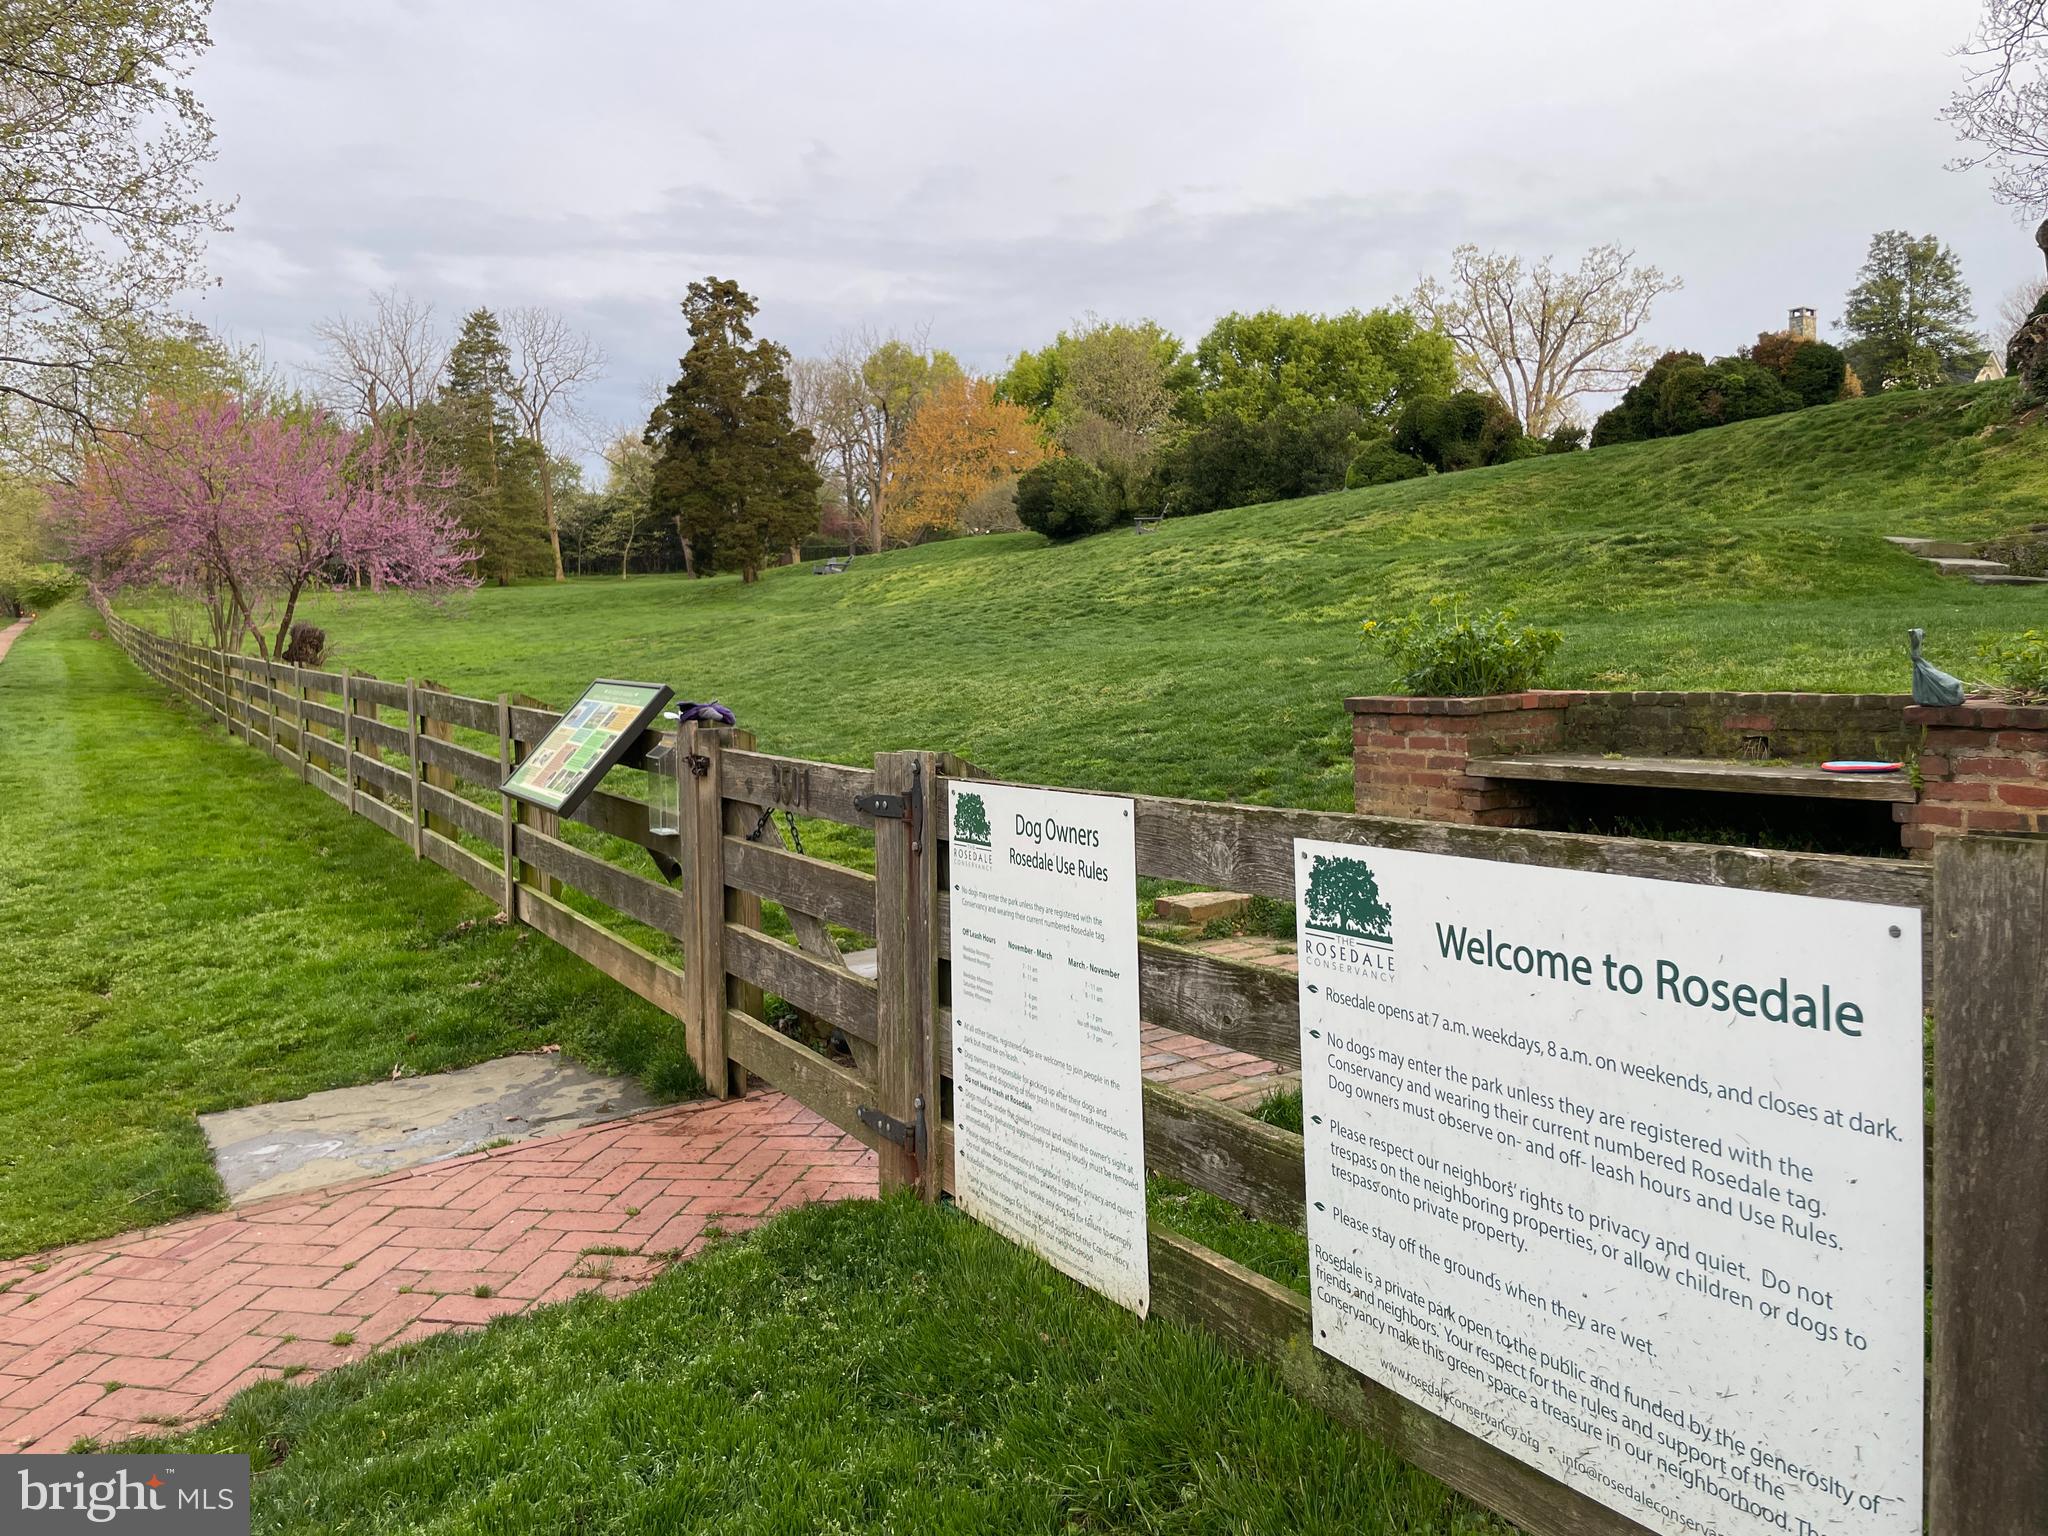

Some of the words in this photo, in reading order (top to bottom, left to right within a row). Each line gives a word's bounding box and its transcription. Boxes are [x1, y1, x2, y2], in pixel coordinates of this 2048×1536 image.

[953, 847, 993, 865] ROSEDALE
[1009, 847, 1054, 872] Rosedale
[1055, 855, 1076, 876] Use
[1078, 859, 1109, 882] Rules
[1015, 813, 1042, 843] Dog
[1045, 817, 1099, 848] Owners
[1007, 940, 1034, 955] November
[1036, 948, 1053, 960] March
[1089, 962, 1120, 979] November
[1305, 939, 1395, 972] ROSEDALE
[1305, 955, 1395, 983] CONSERVANCY
[1335, 934, 1355, 948] THE
[1435, 922, 1593, 986] Welcome
[1602, 953, 1643, 995] to
[1656, 959, 1864, 1037] Rosedale
[1325, 986, 1376, 1013] Rosedale
[1377, 1003, 1415, 1022] opens
[1416, 1012, 1429, 1026] at
[1431, 1012, 1439, 1028] 7
[1442, 1018, 1470, 1037] a.m.
[1471, 1025, 1544, 1057] weekdays,
[1547, 1040, 1557, 1058] 8
[1560, 1047, 1592, 1067] a.m.
[1595, 1056, 1617, 1073] on
[1620, 1061, 1712, 1099] weekends,
[1717, 1084, 1753, 1106] and
[1758, 1091, 1818, 1121] closes
[1823, 1109, 1844, 1128] at
[1849, 1111, 1903, 1142] dark.
[1327, 1031, 1344, 1050] No
[1346, 1037, 1376, 1061] dogs
[1378, 1049, 1405, 1071] may
[1407, 1058, 1442, 1078] enter
[1445, 1065, 1468, 1086] the
[1471, 1075, 1503, 1096] park
[1507, 1085, 1555, 1110] unless
[1558, 1096, 1595, 1125] they
[1599, 1111, 1625, 1130] are
[1630, 1120, 1722, 1157] registered
[1728, 1146, 1772, 1171] with
[1778, 1157, 1814, 1183] the
[1327, 1053, 1404, 1093] Conservancy
[1406, 1080, 1431, 1098] and
[1434, 1088, 1490, 1119] wearing
[1493, 1102, 1529, 1126] their
[1532, 1117, 1590, 1146] current
[1594, 1135, 1686, 1174] numbered
[1692, 1159, 1781, 1202] Rosedale
[1786, 1188, 1826, 1219] tag.
[1328, 1074, 1353, 1099] Dog
[1355, 1086, 1400, 1110] owners
[1402, 1101, 1435, 1122] must
[1438, 1110, 1493, 1140] observe
[1497, 1131, 1522, 1148] on-
[1525, 1139, 1555, 1160] and
[1559, 1149, 1587, 1168] off-
[1591, 1155, 1634, 1185] leash
[1640, 1169, 1691, 1203] hours
[1696, 1193, 1732, 1217] and
[1739, 1201, 1775, 1229] Use
[1782, 1214, 1843, 1251] Rules.
[1330, 1119, 1366, 1145] Please
[1369, 1136, 1414, 1163] respect
[1417, 1153, 1440, 1171] our
[1443, 1162, 1517, 1198] neighbors'
[1520, 1187, 1564, 1216] rights
[1567, 1203, 1585, 1223] to
[1589, 1213, 1651, 1250] privacy
[1655, 1236, 1690, 1260] and
[1695, 1251, 1750, 1282] quiet.
[1762, 1268, 1791, 1295] Do
[1797, 1285, 1833, 1311] not
[1330, 1141, 1378, 1171] trespass
[1380, 1162, 1396, 1178] on
[1399, 1166, 1421, 1187] the
[1423, 1178, 1509, 1224] neighboring
[1513, 1211, 1597, 1255] properties,
[1601, 1244, 1619, 1261] or
[1623, 1250, 1671, 1280] allow
[1675, 1268, 1753, 1311] children
[1759, 1301, 1781, 1320] or
[1786, 1307, 1838, 1342] dogs
[1844, 1328, 1867, 1351] to
[1331, 1162, 1381, 1193] trespass
[1380, 1184, 1410, 1205] onto
[1413, 1197, 1459, 1225] private
[1462, 1216, 1528, 1253] property.
[1333, 1206, 1369, 1235] Please
[1372, 1226, 1396, 1249] stay
[1398, 1237, 1417, 1255] off
[1418, 1243, 1441, 1266] the
[1443, 1257, 1501, 1291] grounds
[1504, 1280, 1547, 1311] when
[1551, 1299, 1586, 1330] they
[1590, 1319, 1616, 1341] are
[1620, 1331, 1657, 1358] wet.
[1315, 1243, 1363, 1279] Rosedale
[1364, 1267, 1373, 1284] is
[1373, 1275, 1382, 1290] a
[1384, 1280, 1426, 1309] private
[1428, 1300, 1456, 1324] park
[1458, 1315, 1493, 1340] open
[1495, 1329, 1513, 1350] to
[1513, 1337, 1537, 1361] the
[1540, 1351, 1587, 1384] public
[1590, 1374, 1620, 1399] and
[1623, 1385, 1684, 1429] funded
[1689, 1413, 1712, 1443] by
[1713, 1428, 1746, 1457] the
[1750, 1447, 1855, 1506] generosity
[1858, 1494, 1884, 1514] of
[1315, 1264, 1353, 1299] friends
[1351, 1286, 1375, 1308] and
[1377, 1298, 1442, 1338] neighbors.
[1443, 1326, 1474, 1354] Your
[1476, 1345, 1527, 1380] respect
[1529, 1366, 1550, 1390] for
[1551, 1379, 1578, 1404] the
[1580, 1395, 1618, 1423] rules
[1621, 1414, 1653, 1440] and
[1657, 1431, 1727, 1475] support
[1730, 1465, 1751, 1484] of
[1753, 1472, 1785, 1501] the
[1316, 1285, 1386, 1335] Conservancy
[1387, 1324, 1420, 1350] make
[1422, 1339, 1445, 1363] this
[1446, 1354, 1485, 1383] green
[1487, 1374, 1527, 1404] space
[1530, 1395, 1538, 1410] a
[1541, 1398, 1603, 1441] treasure
[1606, 1427, 1621, 1450] in
[1624, 1442, 1654, 1465] our
[1657, 1456, 1793, 1532] neighborhood.
